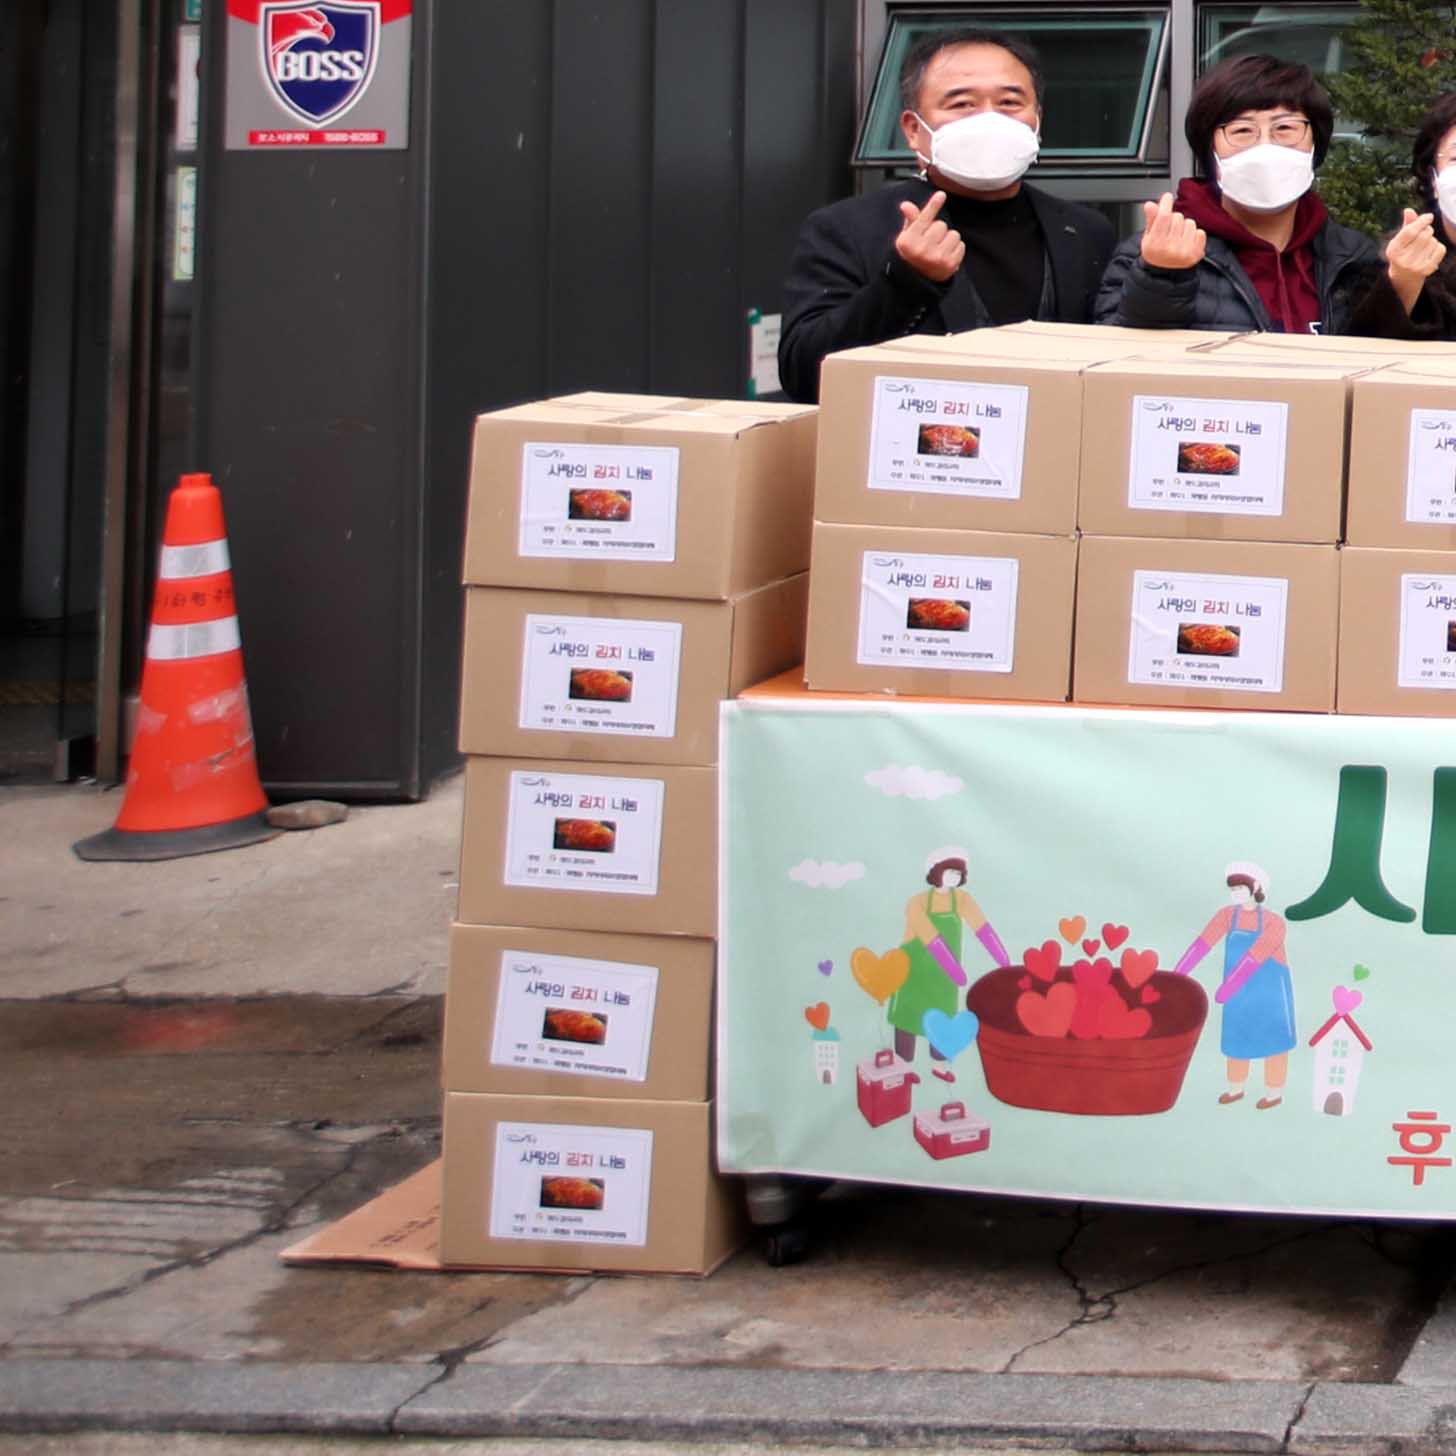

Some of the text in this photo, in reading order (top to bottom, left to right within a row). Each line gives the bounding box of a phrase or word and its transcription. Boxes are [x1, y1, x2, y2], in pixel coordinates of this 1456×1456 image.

[277, 51, 364, 81] BOSS
[897, 398, 937, 414] 사랑의
[942, 400, 970, 415] 김치
[1156, 416, 1197, 432] 사랑의
[1201, 418, 1229, 433] 김치
[547, 462, 587, 478] 사랑의
[593, 464, 620, 479] 김치
[886, 572, 927, 588] 사랑의
[931, 574, 960, 589] 김치
[1156, 597, 1197, 613] 사랑의
[1202, 599, 1229, 614] 김치
[549, 642, 589, 657] 사랑의
[594, 644, 622, 659] 김치
[534, 791, 573, 808] 사랑의
[578, 794, 605, 809] 김치
[524, 981, 565, 998] 사랑의
[569, 985, 598, 1001] 김치
[519, 1150, 560, 1165] 사랑의
[566, 1152, 593, 1166] 김치
